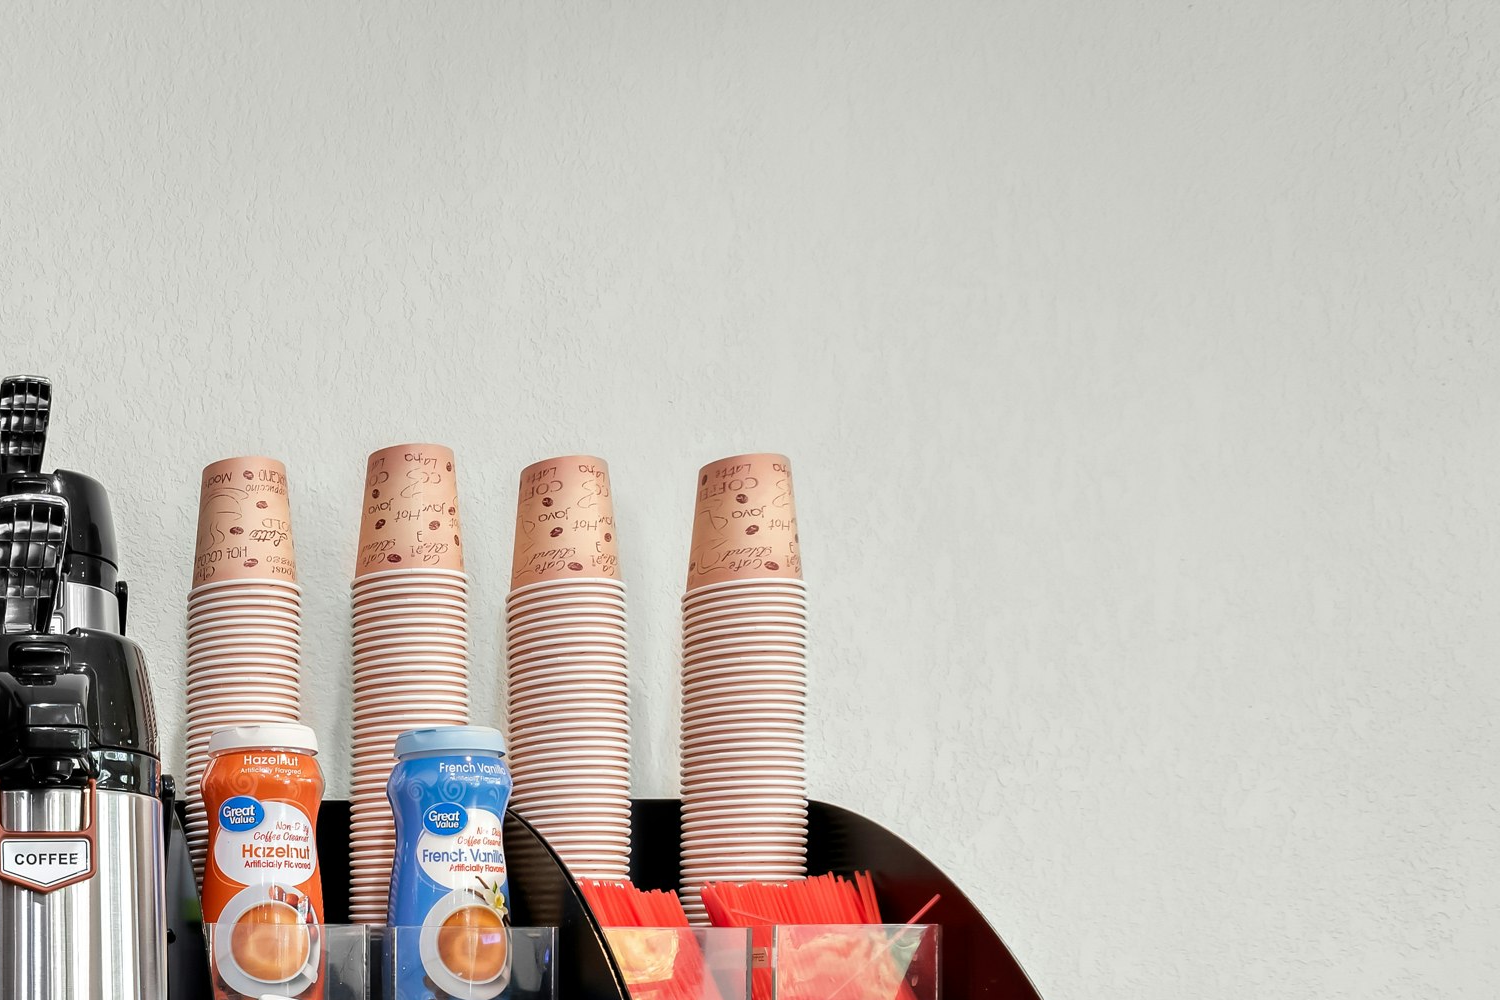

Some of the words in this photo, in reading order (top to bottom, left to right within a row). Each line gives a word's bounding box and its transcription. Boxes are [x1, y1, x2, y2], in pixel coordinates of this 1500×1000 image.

[394, 510, 420, 522] Hot
[572, 520, 597, 532] Hot
[768, 519, 790, 530] Hot
[243, 755, 298, 767] Hazelnut
[440, 763, 476, 773] French
[222, 804, 255, 818] Great
[428, 810, 460, 822] Great
[230, 816, 255, 824] Value
[435, 820, 459, 829] Value
[253, 831, 281, 843] Coffee
[242, 844, 310, 860] Hazelnut
[422, 848, 467, 863] French
[469, 848, 504, 864] Vanilla
[14, 853, 78, 866] COFFEE
[244, 860, 282, 869] Artificially
[449, 864, 484, 873] Artificially
